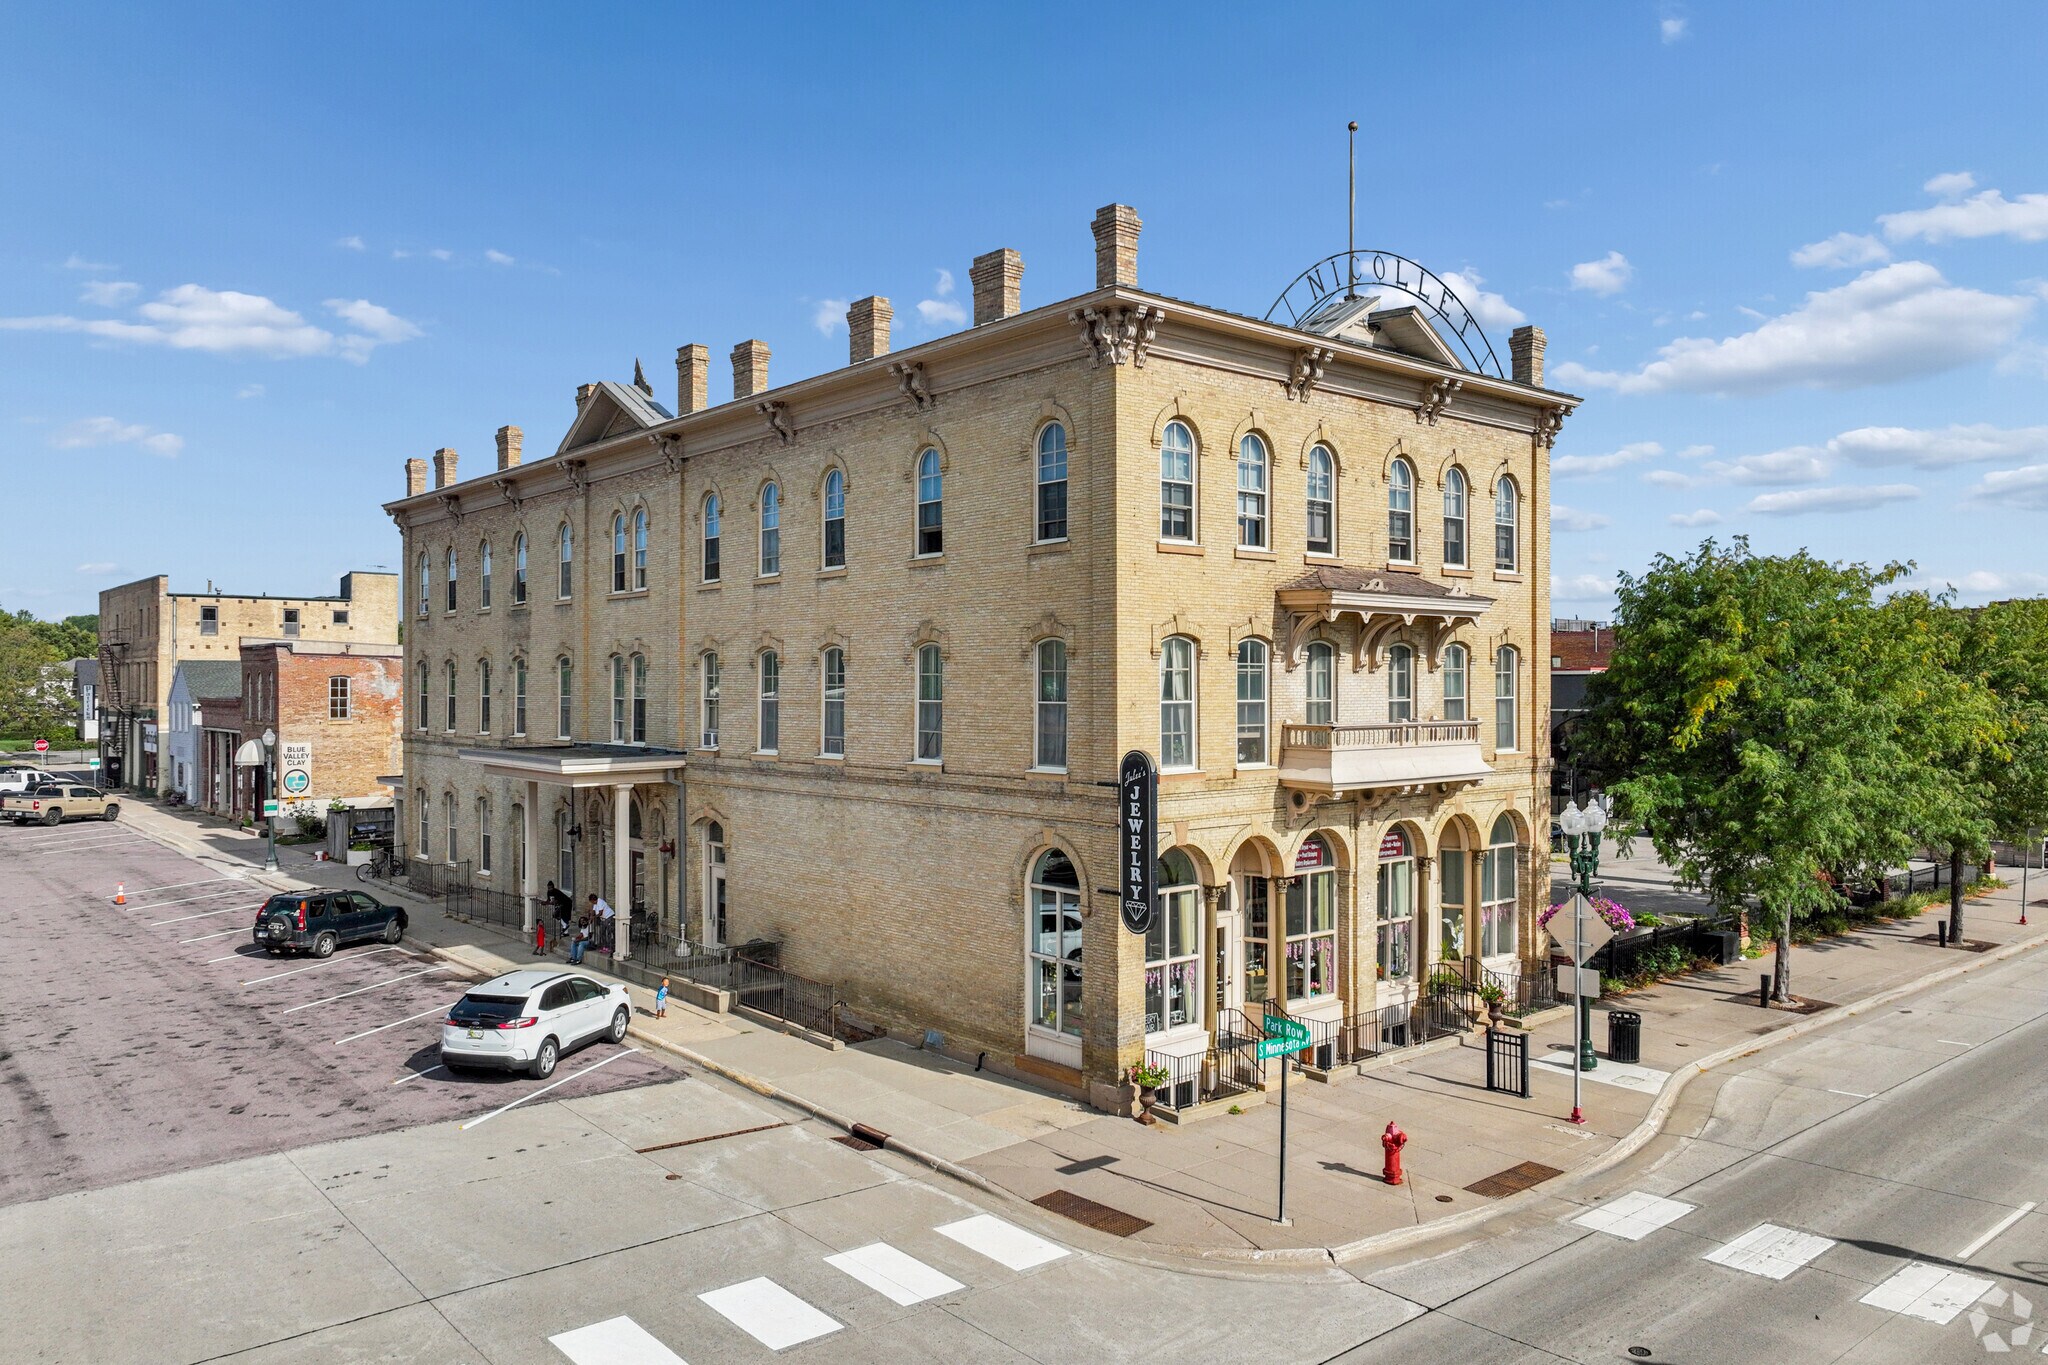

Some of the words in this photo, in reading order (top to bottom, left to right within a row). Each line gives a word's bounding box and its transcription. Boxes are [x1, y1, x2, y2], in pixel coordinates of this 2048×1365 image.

[1306, 255, 1474, 338] NICOLLET
[1128, 786, 1143, 900] JEWELRY
[1258, 1044, 1263, 1057] S
[1265, 1039, 1300, 1056] Minnesota
[1266, 1017, 1283, 1034] Park
[1285, 1024, 1304, 1039] Row
